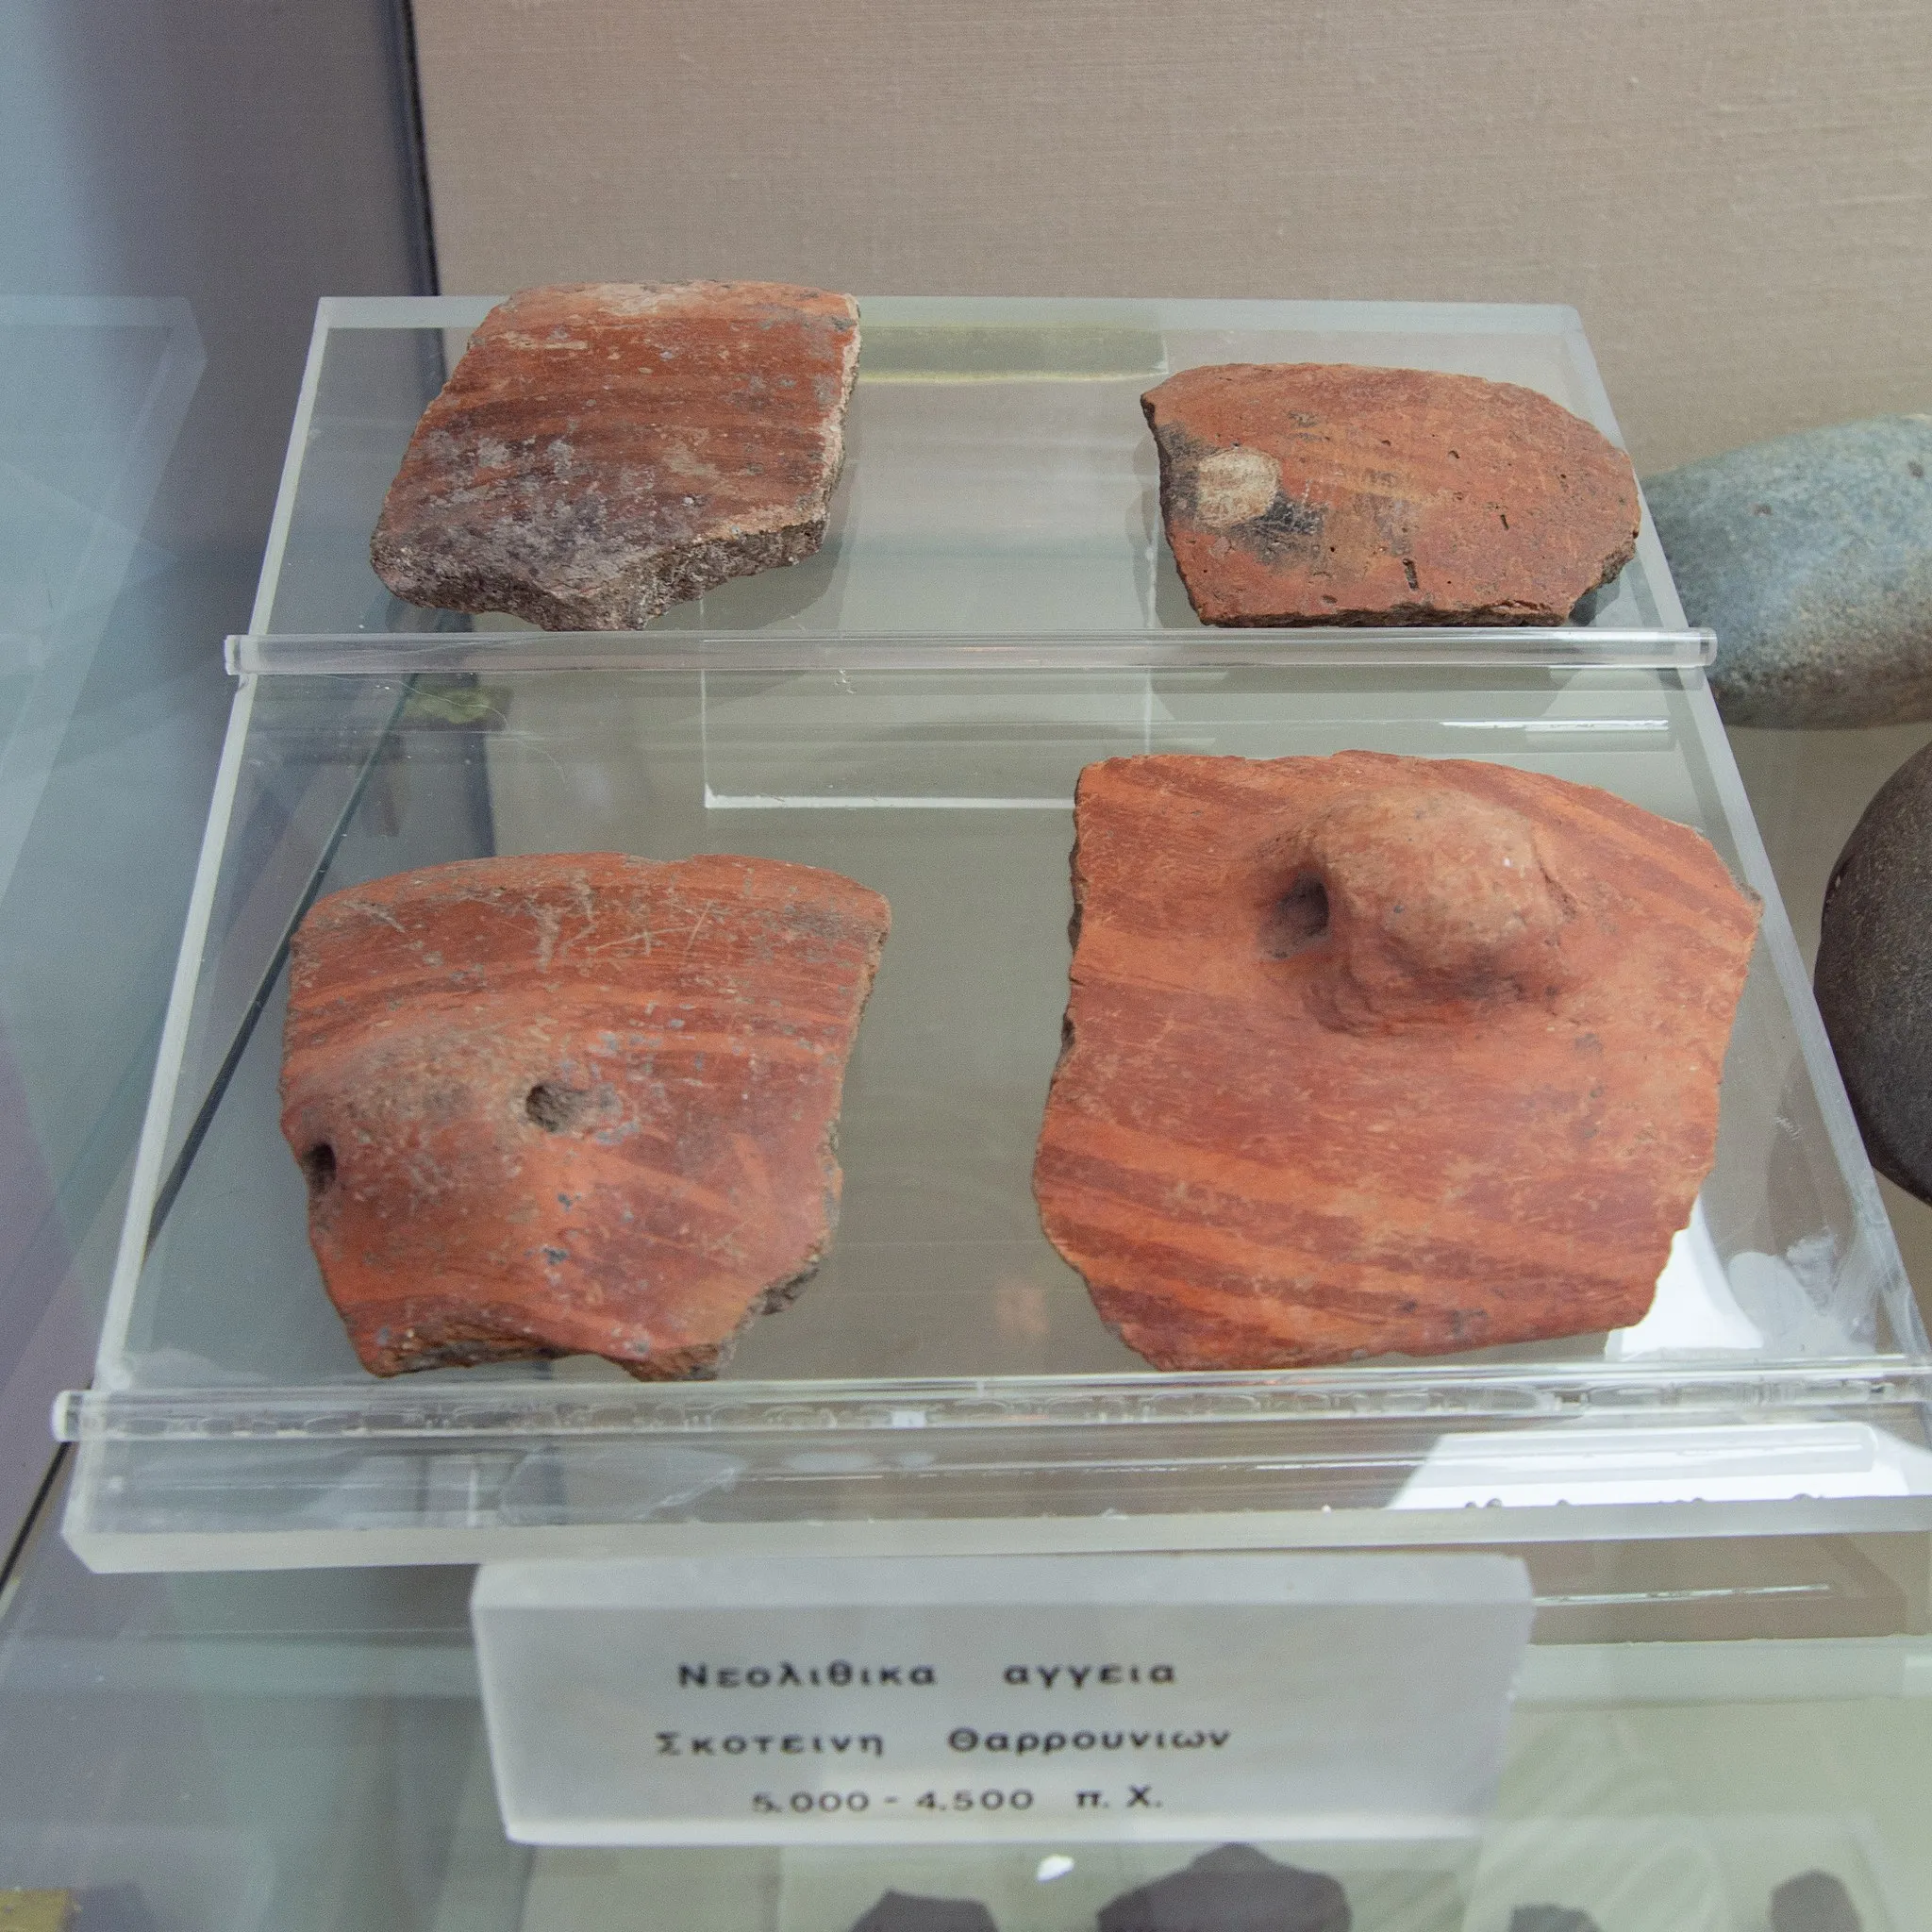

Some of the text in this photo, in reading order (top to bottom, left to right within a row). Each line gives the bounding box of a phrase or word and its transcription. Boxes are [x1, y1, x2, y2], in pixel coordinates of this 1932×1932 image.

[676, 1658, 1175, 1690] Νεολιθικα αγγεια
[654, 1726, 1231, 1758] Σκοτεινη Θαρρουνιων
[751, 1790, 870, 1814] 5.000
[915, 1789, 1036, 1812] 4.500
